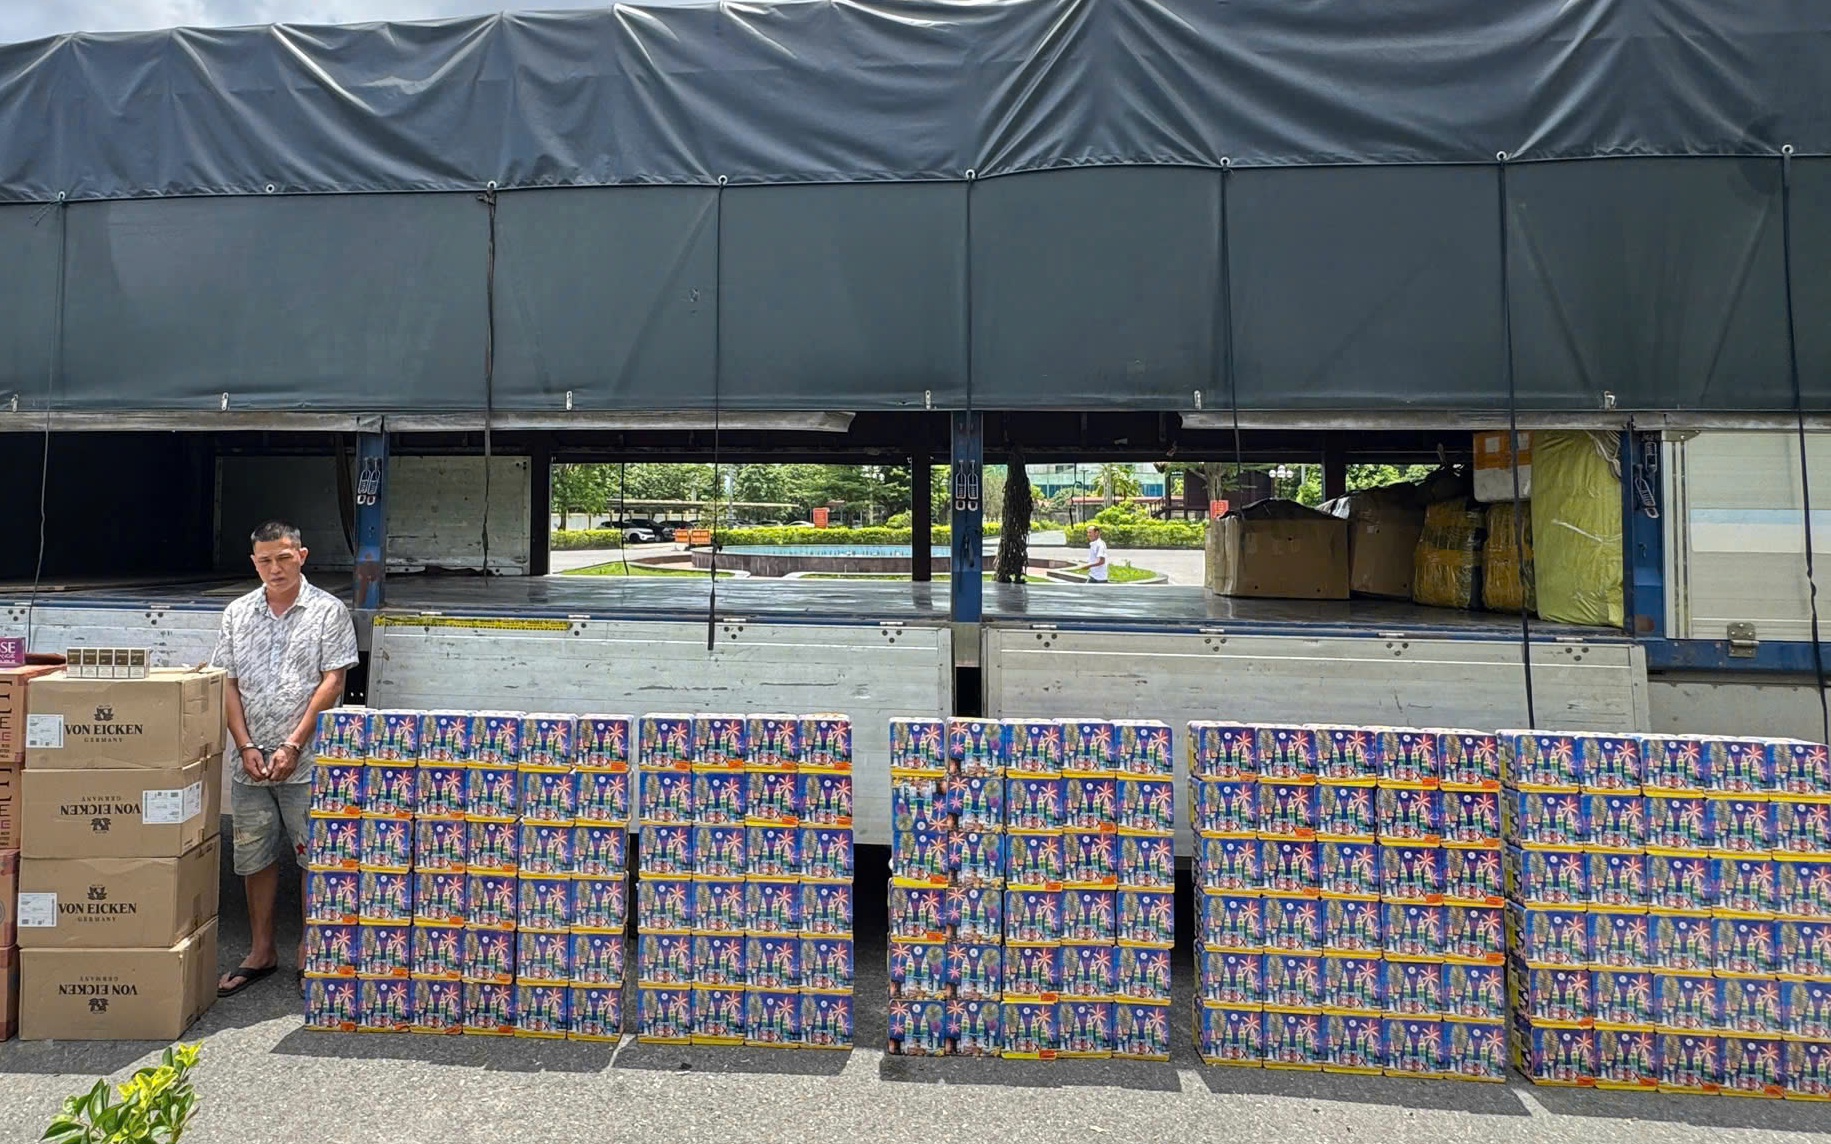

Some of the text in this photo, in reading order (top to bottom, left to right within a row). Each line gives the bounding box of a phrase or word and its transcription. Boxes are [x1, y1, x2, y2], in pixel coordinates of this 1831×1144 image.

[64, 724, 144, 735] VON EICKEN
[60, 803, 142, 816] VON EICKEN
[58, 903, 138, 914] VON EICKEN
[59, 984, 138, 996] VON EICKEN
